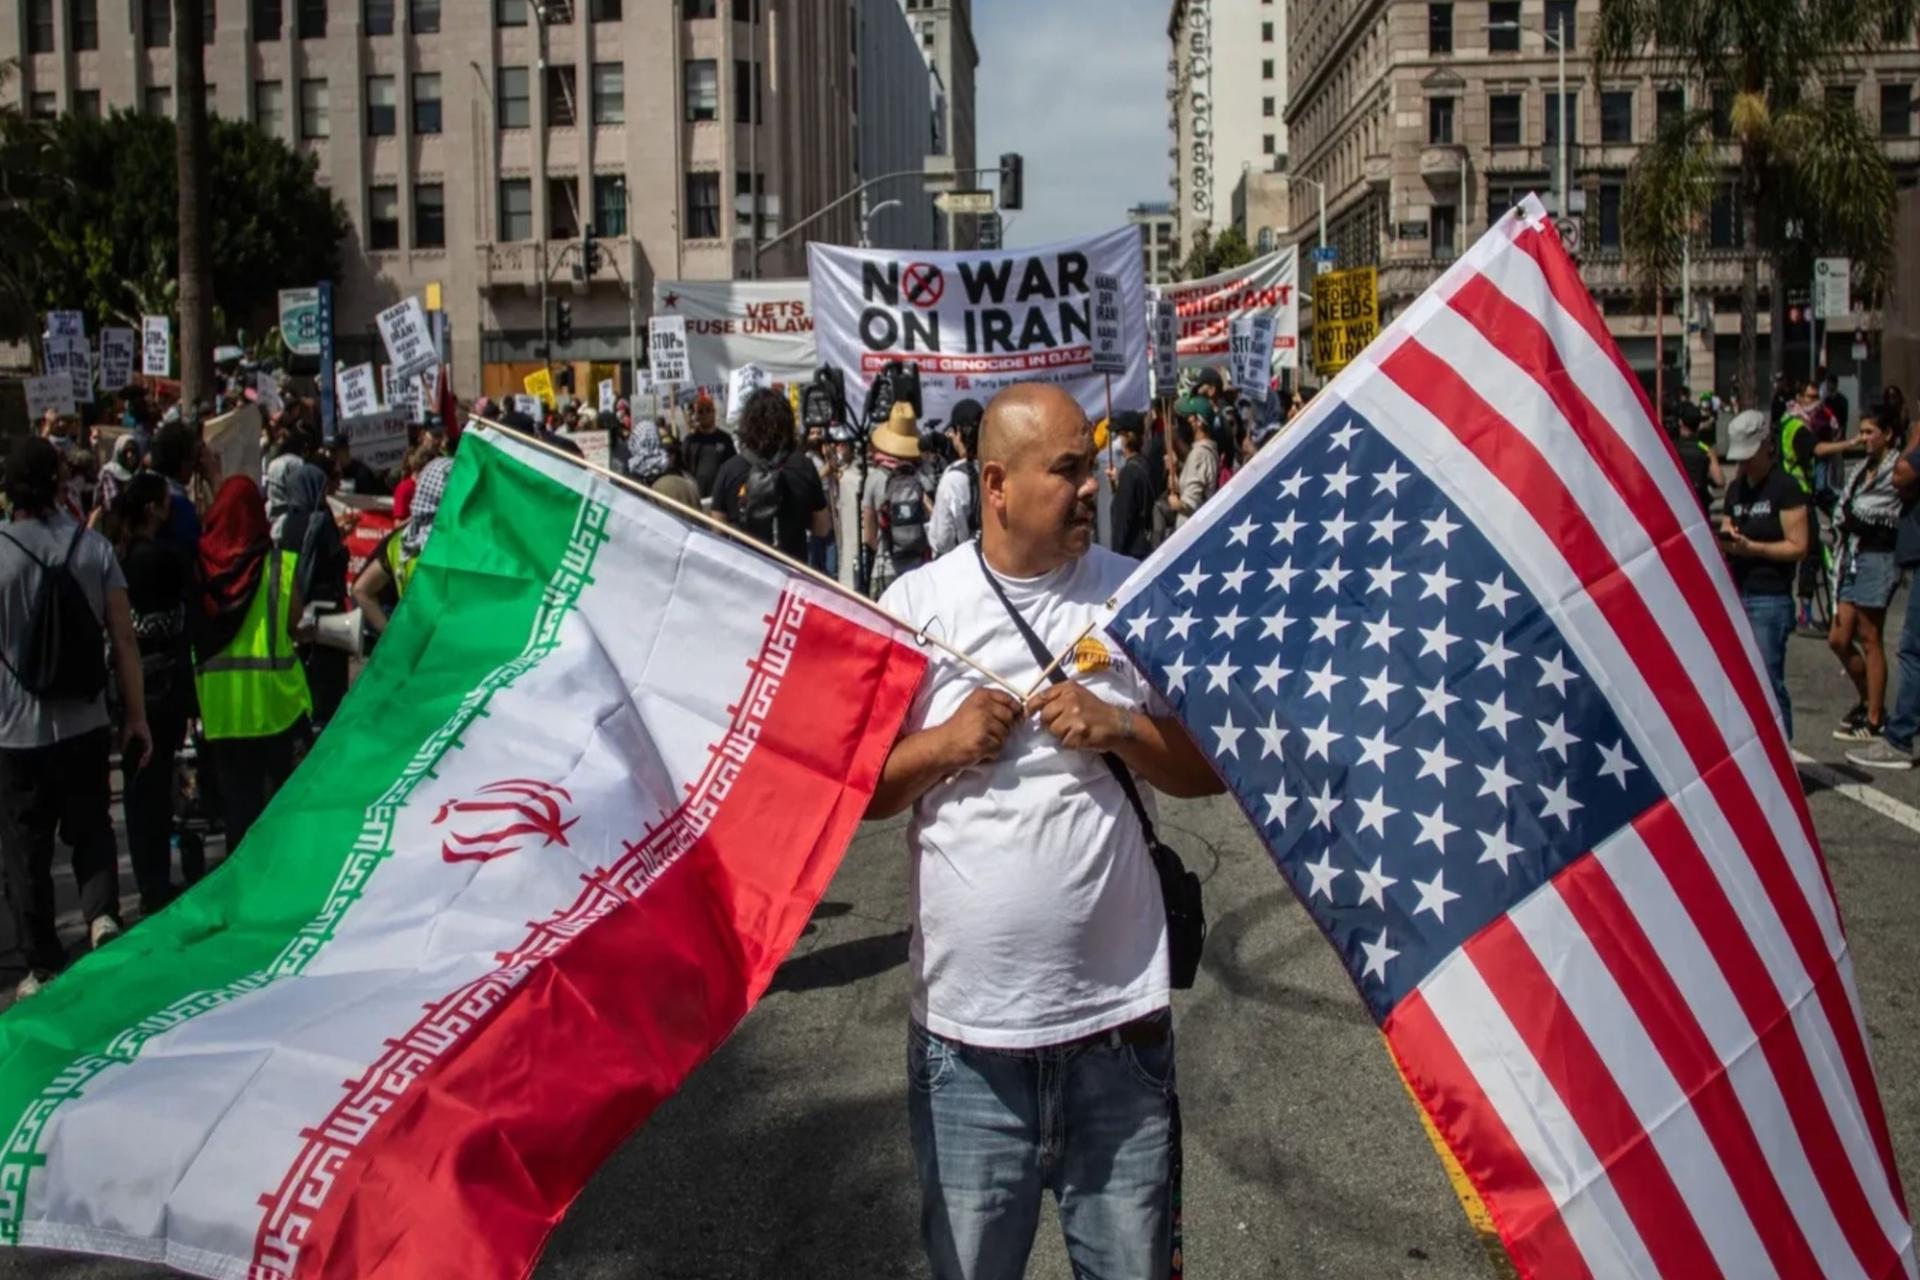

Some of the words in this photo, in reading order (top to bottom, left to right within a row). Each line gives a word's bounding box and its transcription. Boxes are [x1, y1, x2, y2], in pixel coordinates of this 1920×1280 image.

[957, 251, 1090, 304] WAR
[383, 301, 411, 321] HANDS
[745, 300, 805, 319] VETS
[1317, 298, 1373, 322] NEEDS
[685, 319, 735, 335] FUSE
[742, 318, 814, 334] UNLAW
[858, 306, 941, 352] ON
[964, 298, 1091, 353] IRAN
[1318, 326, 1344, 344] NOT
[1345, 321, 1374, 340] WAR
[652, 332, 675, 350] STOP
[939, 357, 1025, 372] GENOCIDE
[1028, 355, 1046, 369] IN
[656, 368, 685, 380] IRAN!
